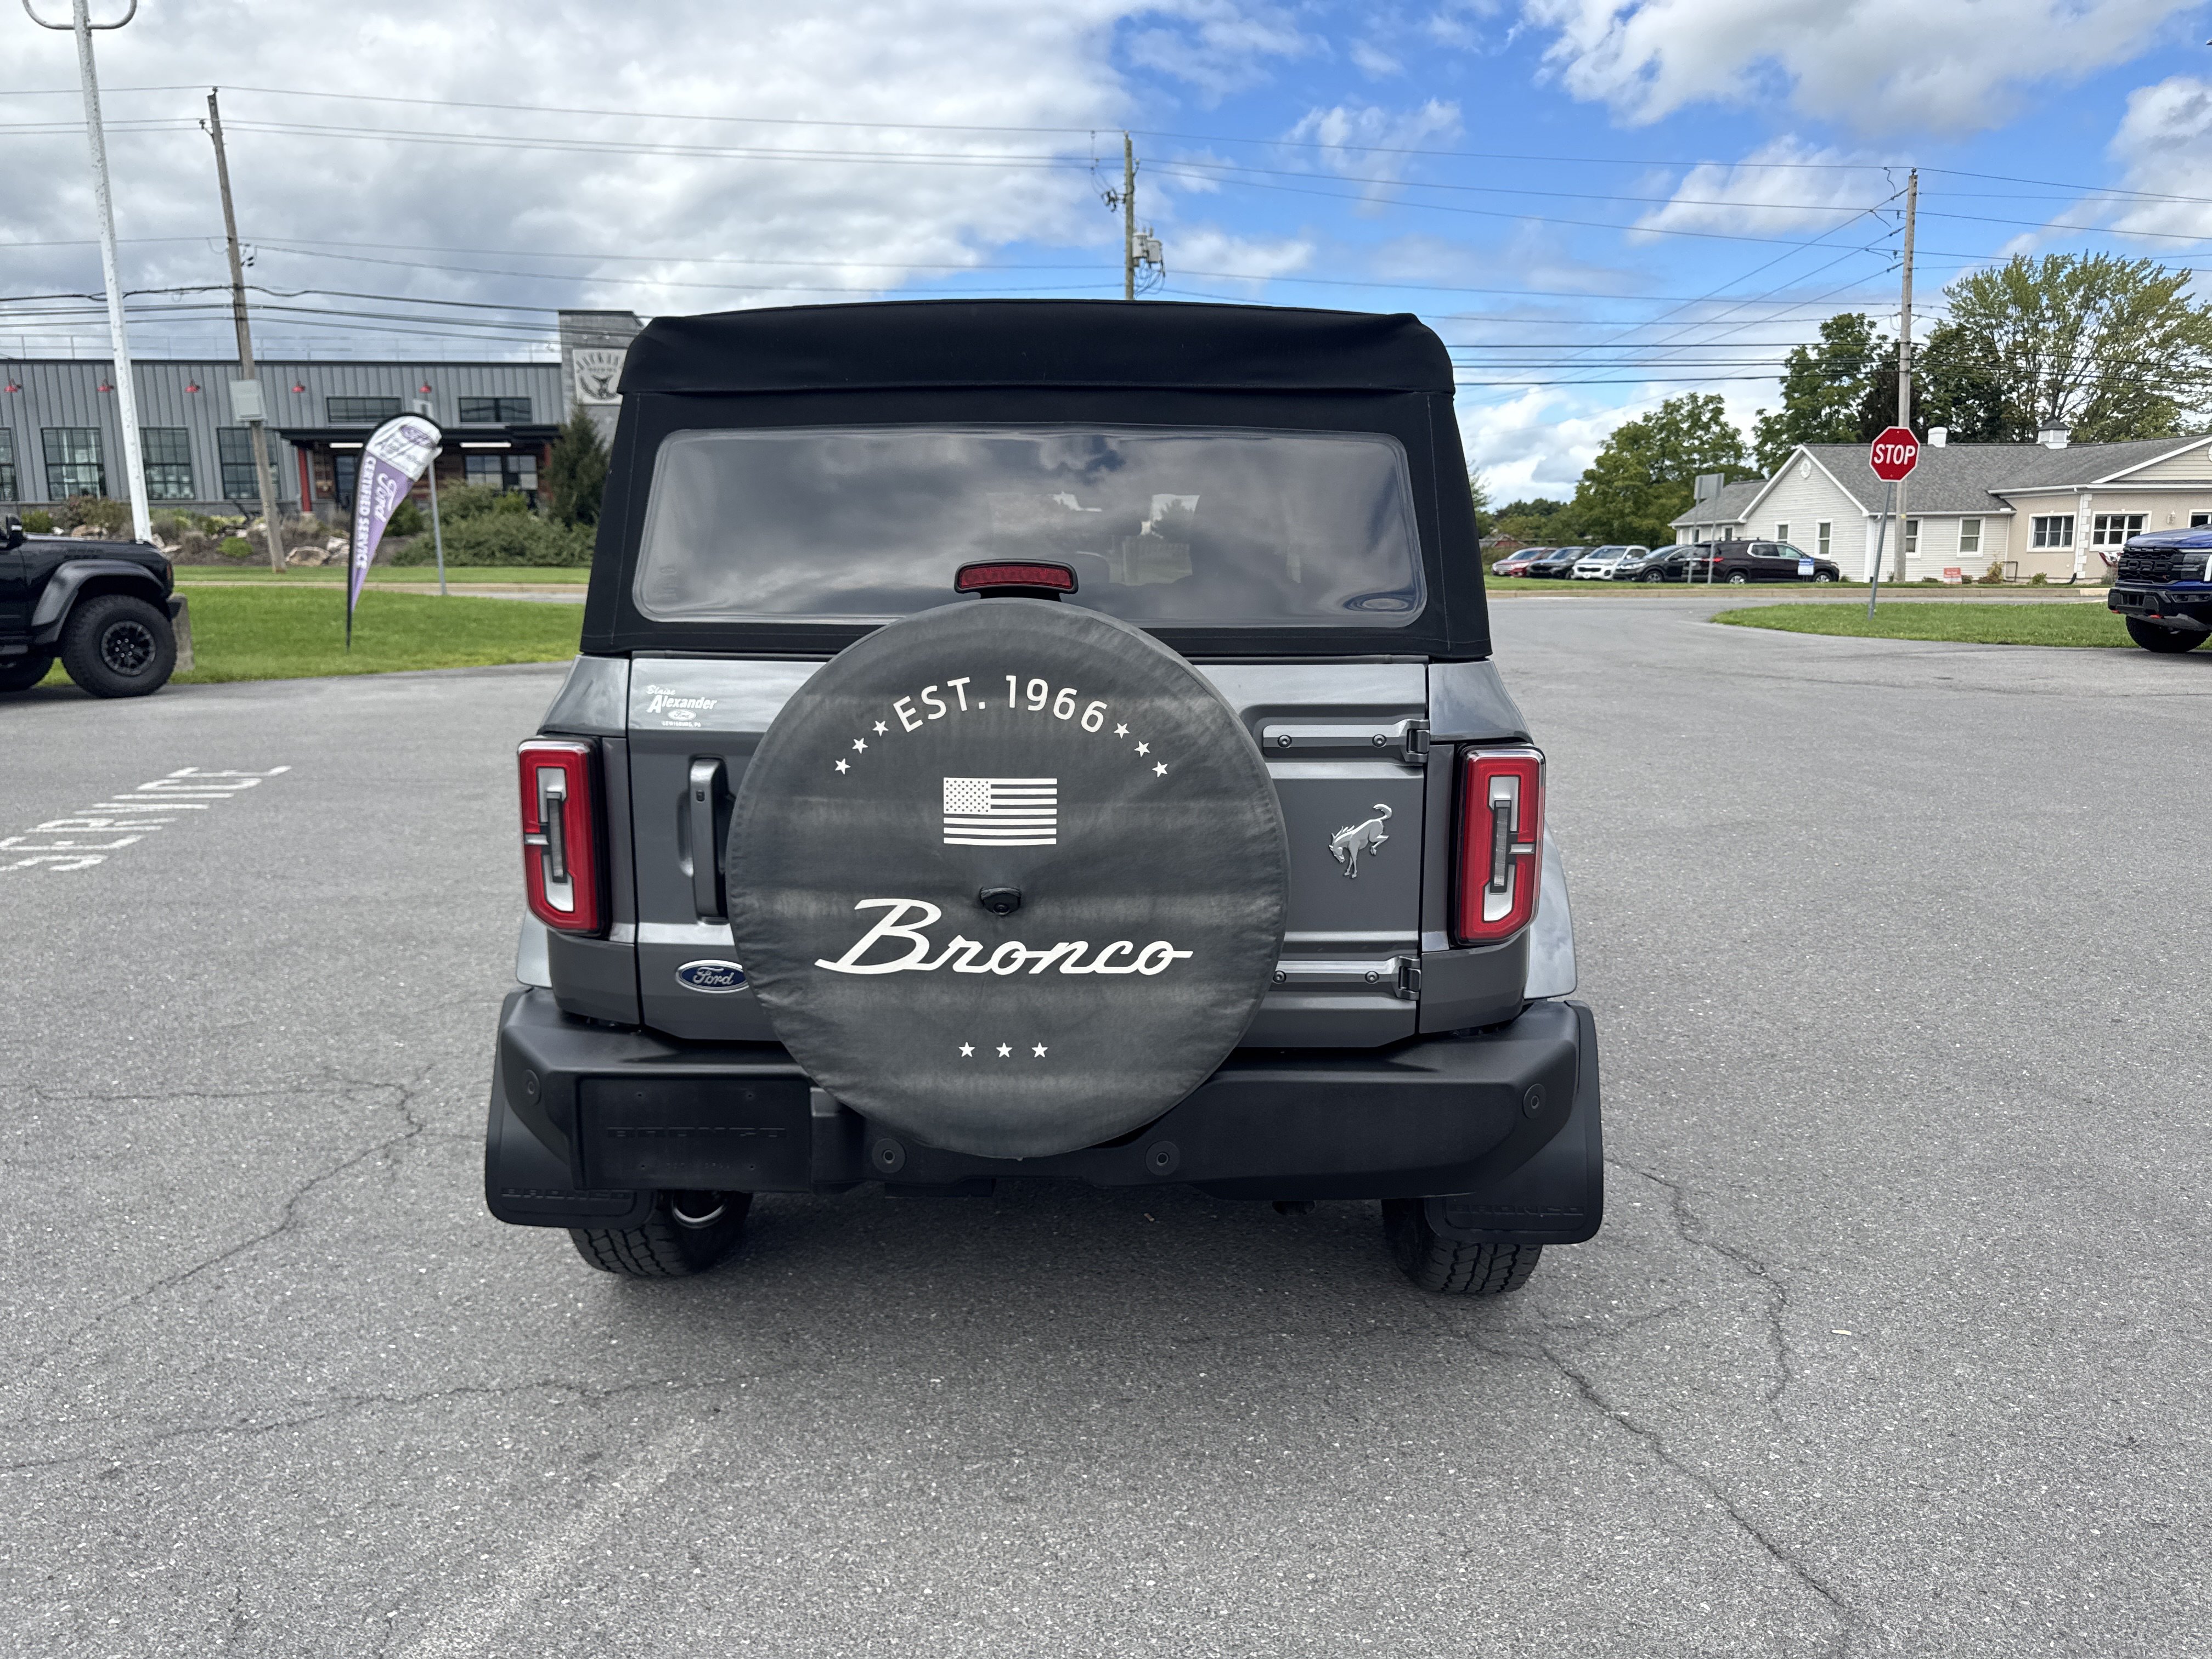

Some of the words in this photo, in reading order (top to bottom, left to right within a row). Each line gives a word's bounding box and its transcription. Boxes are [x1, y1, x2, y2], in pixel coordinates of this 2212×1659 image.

[1874, 443, 1916, 465] STOP
[359, 456, 376, 516] CERTIFIED
[374, 472, 397, 522] Ford
[356, 517, 370, 569] SERVICE
[2118, 559, 2173, 571] FORD
[646, 695, 718, 713] Alexander
[893, 676, 986, 732] EST.
[1005, 674, 1108, 733] 1966
[0, 765, 292, 872] SERVICE
[814, 898, 1194, 975] Bronco
[692, 966, 735, 985] Ford
